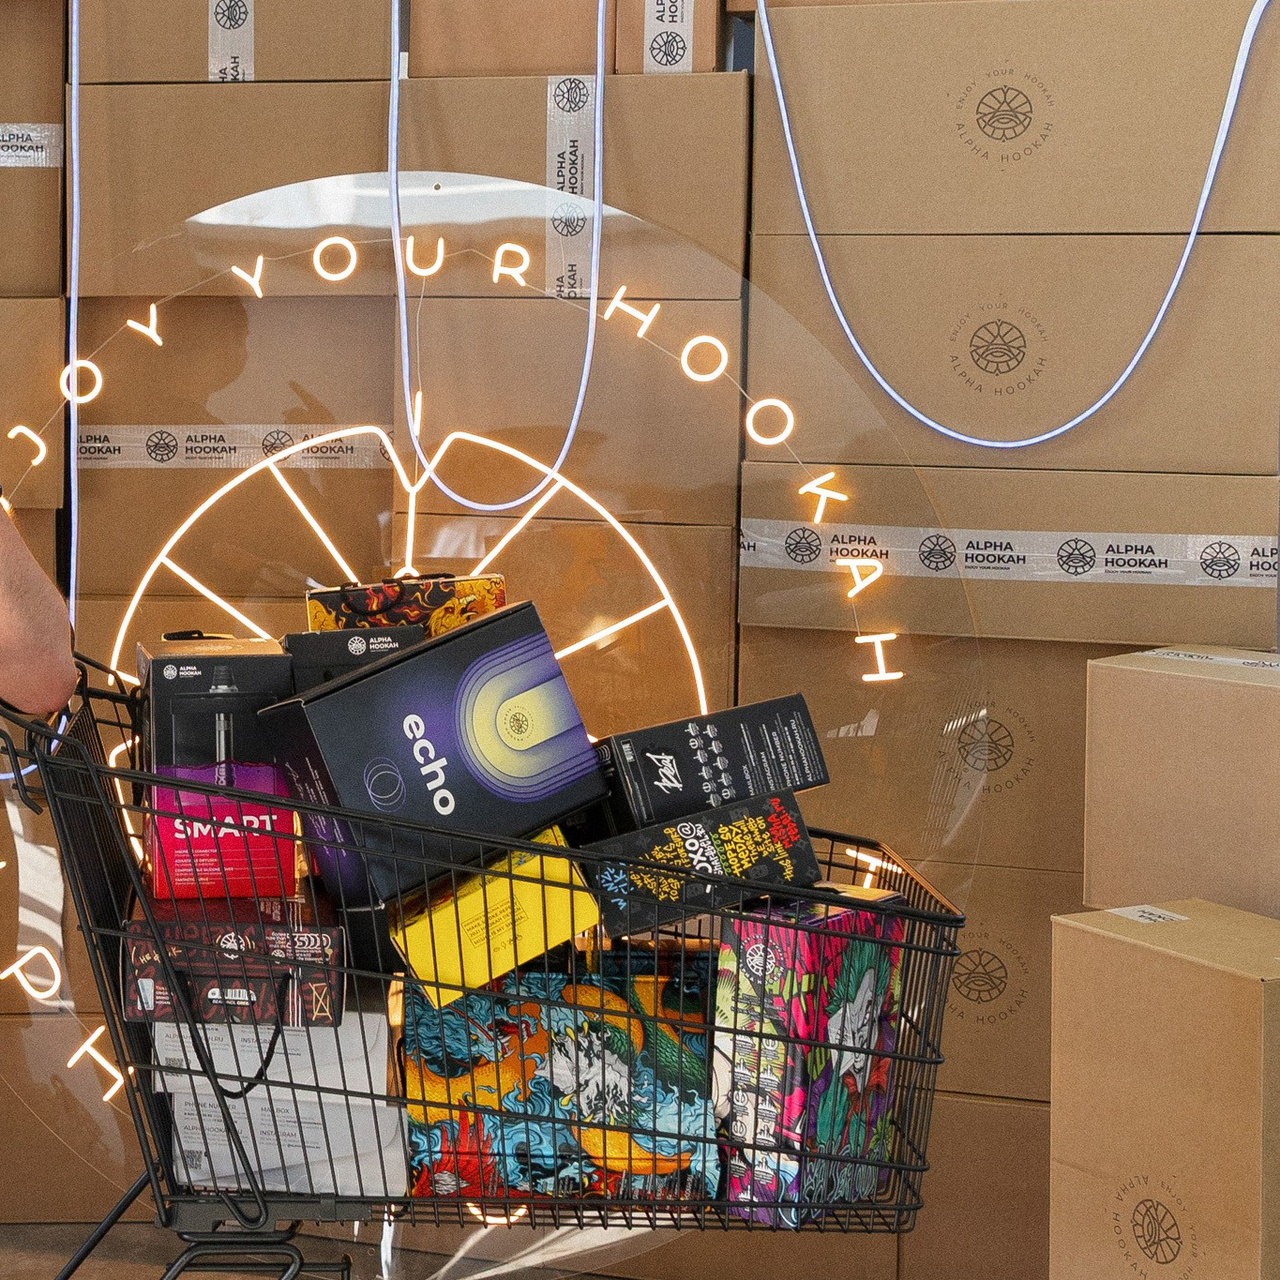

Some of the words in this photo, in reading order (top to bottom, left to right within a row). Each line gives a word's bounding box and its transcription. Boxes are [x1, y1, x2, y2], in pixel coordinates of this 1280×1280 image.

[986, 69, 1015, 78] YOUR
[1023, 73, 1055, 107] HOOKAH
[956, 123, 990, 160] ALPHA
[1001, 122, 1054, 162] HOOKAH
[557, 151, 566, 191] ALPHA
[568, 140, 578, 195] HOOKAH
[950, 355, 983, 393] ALPHA
[994, 357, 1048, 396] HOOKAH
[77, 435, 110, 444] LPHA
[77, 446, 121, 455] OOKAH
[185, 435, 226, 444] ALPHA
[185, 445, 237, 455] HOOKAH
[301, 445, 354, 455] HOOKAH
[6, 302, 164, 468] JOY
[231, 235, 532, 298] YOUR
[603, 284, 906, 683] HOOKAH
[829, 547, 889, 560] HOOKAH
[831, 534, 877, 546] ALPHA
[965, 540, 1014, 552] ALPHA
[1105, 544, 1155, 555] ALPHA
[964, 553, 1027, 565] HOOKAH
[1104, 557, 1169, 569] HOOKAH
[369, 642, 399, 650] HOOKAH
[771, 731, 785, 762] NUMBER
[790, 719, 813, 782] ALPHAHOOKAH.RU
[403, 714, 455, 816] echo
[760, 751, 776, 791] INSTAGRAM
[780, 762, 793, 787] PHONE
[982, 757, 1035, 794] HOOKAH
[742, 764, 756, 796] MAILBOX
[174, 815, 278, 839] SMART
[976, 989, 1029, 1025] HOOKAH
[1115, 1175, 1149, 1202] ALPHA
[1112, 1212, 1148, 1280] HOOKAH
